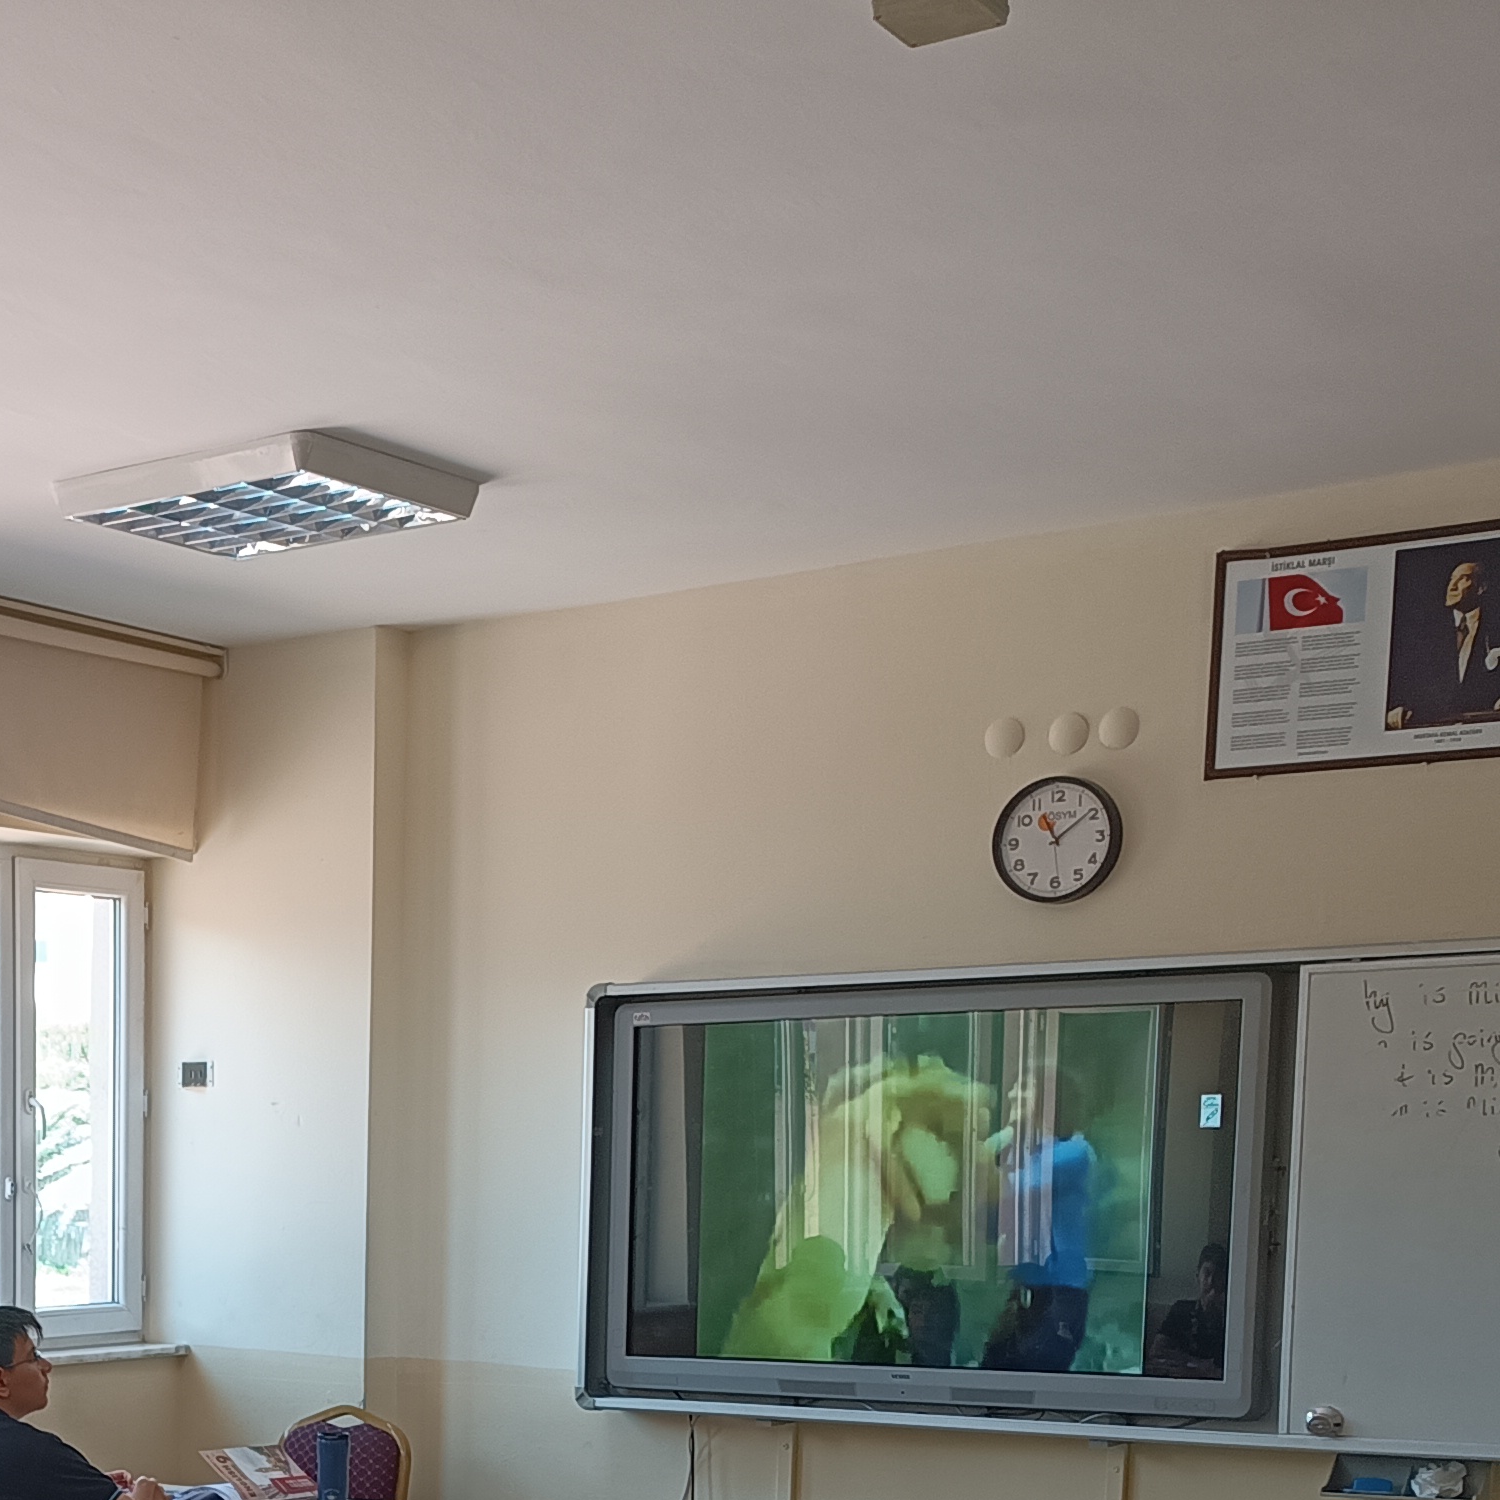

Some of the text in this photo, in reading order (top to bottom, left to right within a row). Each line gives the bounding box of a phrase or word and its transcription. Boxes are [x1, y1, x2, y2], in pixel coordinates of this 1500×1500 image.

[1308, 556, 1336, 568] MARŞI
[1051, 790, 1066, 803] 12
[1032, 798, 1042, 811] 11
[1017, 814, 1033, 828] 10
[1088, 807, 1099, 821] 2
[1095, 829, 1106, 842] 3
[1008, 837, 1020, 851] 9
[1013, 858, 1025, 872] 8
[1087, 852, 1098, 865] 4
[1026, 872, 1039, 886] 7
[1050, 875, 1061, 889] 6
[1073, 868, 1084, 882] 5
